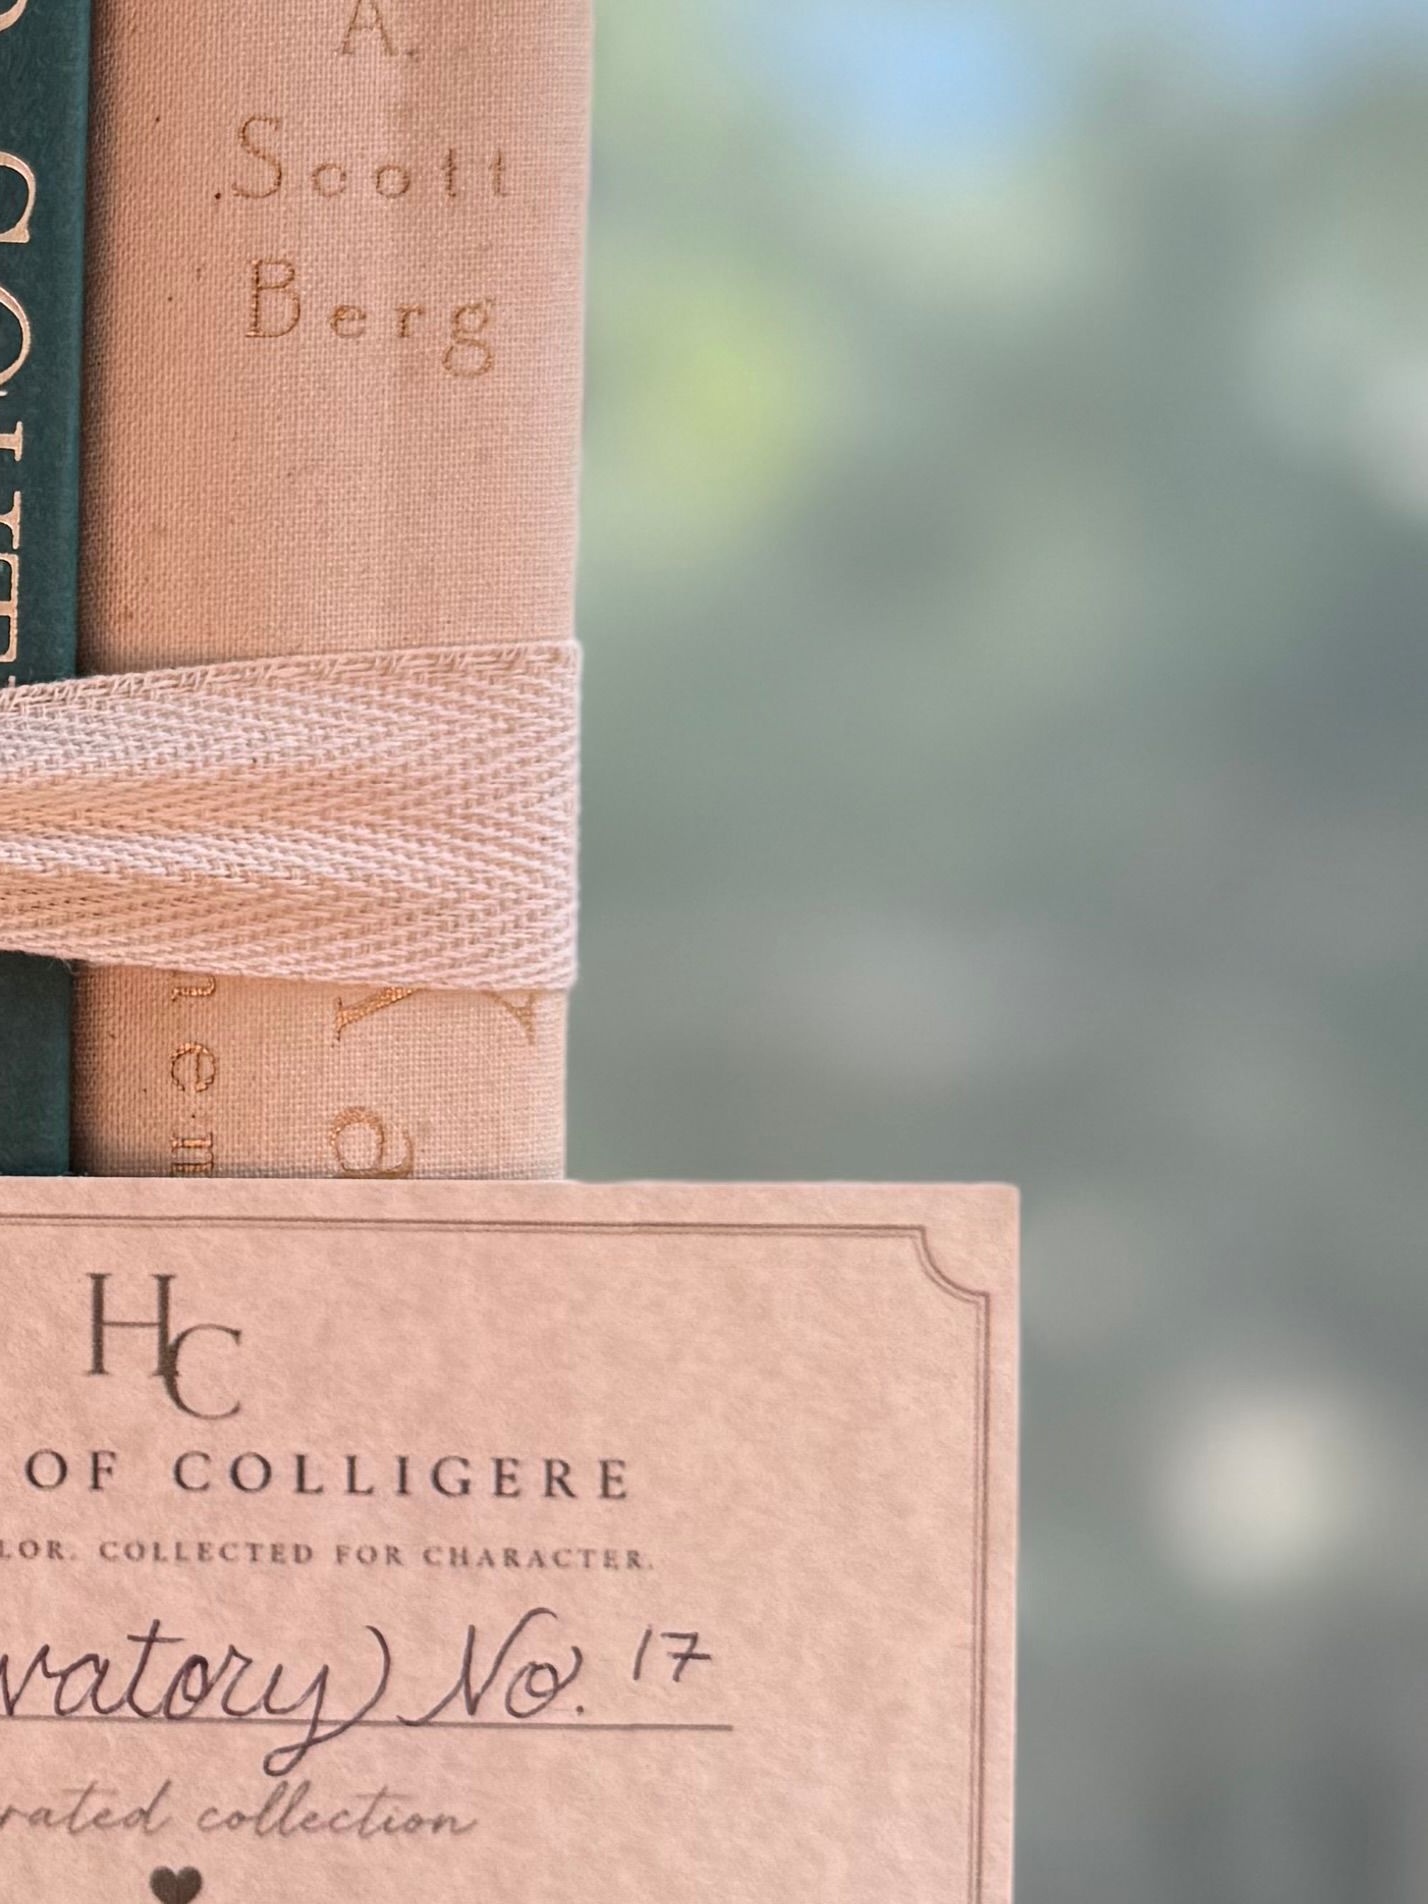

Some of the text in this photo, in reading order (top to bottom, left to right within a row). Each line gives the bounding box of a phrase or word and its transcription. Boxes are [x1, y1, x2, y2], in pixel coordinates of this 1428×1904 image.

[231, 113, 510, 199] Scott
[244, 257, 495, 379] Berg
[23, 1448, 120, 1493] OF
[172, 1450, 631, 1502] COLLIGERE
[98, 1540, 314, 1566] COLLECTED
[335, 1544, 404, 1567] FOR
[422, 1546, 655, 1573] CHARACTER.
[397, 1606, 586, 1726] No.
[633, 1623, 712, 1684] 17
[196, 1780, 479, 1843] collection
